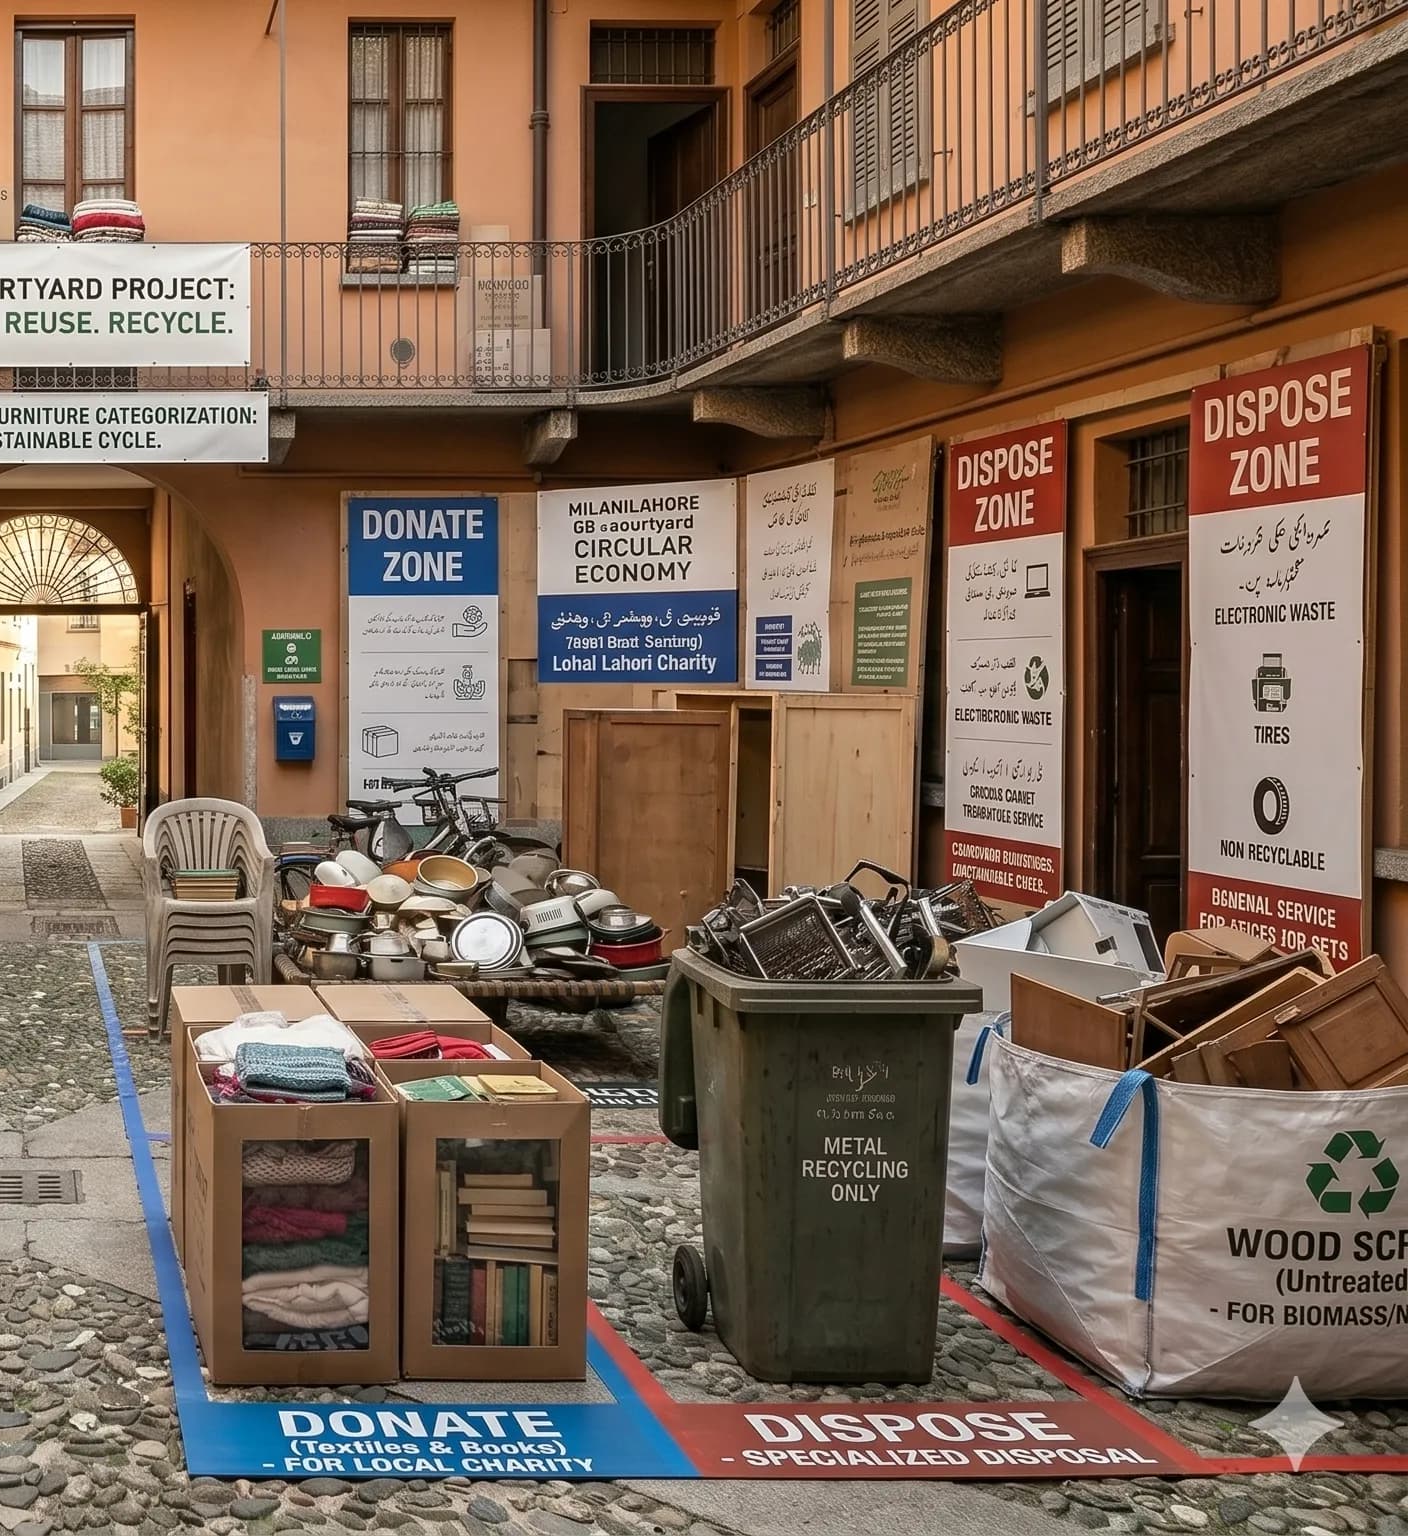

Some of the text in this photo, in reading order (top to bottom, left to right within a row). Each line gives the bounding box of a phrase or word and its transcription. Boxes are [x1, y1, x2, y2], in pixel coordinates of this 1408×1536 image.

[111, 277, 235, 301] PROJECT:
[5, 311, 99, 334] REUSE.
[109, 311, 234, 334] RECYCLE.
[95, 406, 258, 425] CATEGORIZATION:
[1204, 367, 1352, 444] DISPOSE
[98, 431, 162, 449] CYCLE.
[957, 436, 1054, 491] DISPOSE
[1229, 437, 1321, 497] ZONE
[568, 495, 700, 517] MILANILAHORE
[974, 489, 1035, 533] ZONE
[362, 509, 484, 540] DONATE
[573, 520, 595, 534] GB
[574, 535, 693, 559] CIRCULAR
[382, 551, 464, 582] ZONE
[575, 561, 692, 584] ECONOMY
[1215, 601, 1336, 625] ELECTRONIC WASTE
[553, 653, 717, 674] Lohal Lahori Charity
[1021, 710, 1053, 726] WASTE
[1254, 725, 1290, 746] TIRES
[1220, 839, 1326, 872] NON RECYCLABLE
[1277, 898, 1337, 929] SERVICE
[824, 1136, 888, 1155] METAL
[802, 1159, 909, 1179] RECYCLING
[831, 1183, 881, 1202] ONLY
[1226, 1226, 1342, 1262] WOOD
[1226, 1301, 1275, 1325] FOR
[277, 1410, 562, 1438] DONATE
[743, 1411, 1076, 1443] DISPOSE
[290, 1438, 568, 1456] (Textiles & Books)
[743, 1449, 984, 1468] SPECIALIZED
[985, 1447, 1160, 1466] DISPOSAL
[286, 1457, 350, 1472] FOR
[359, 1457, 469, 1472] LOCAL
[474, 1457, 594, 1472] CHARITY
